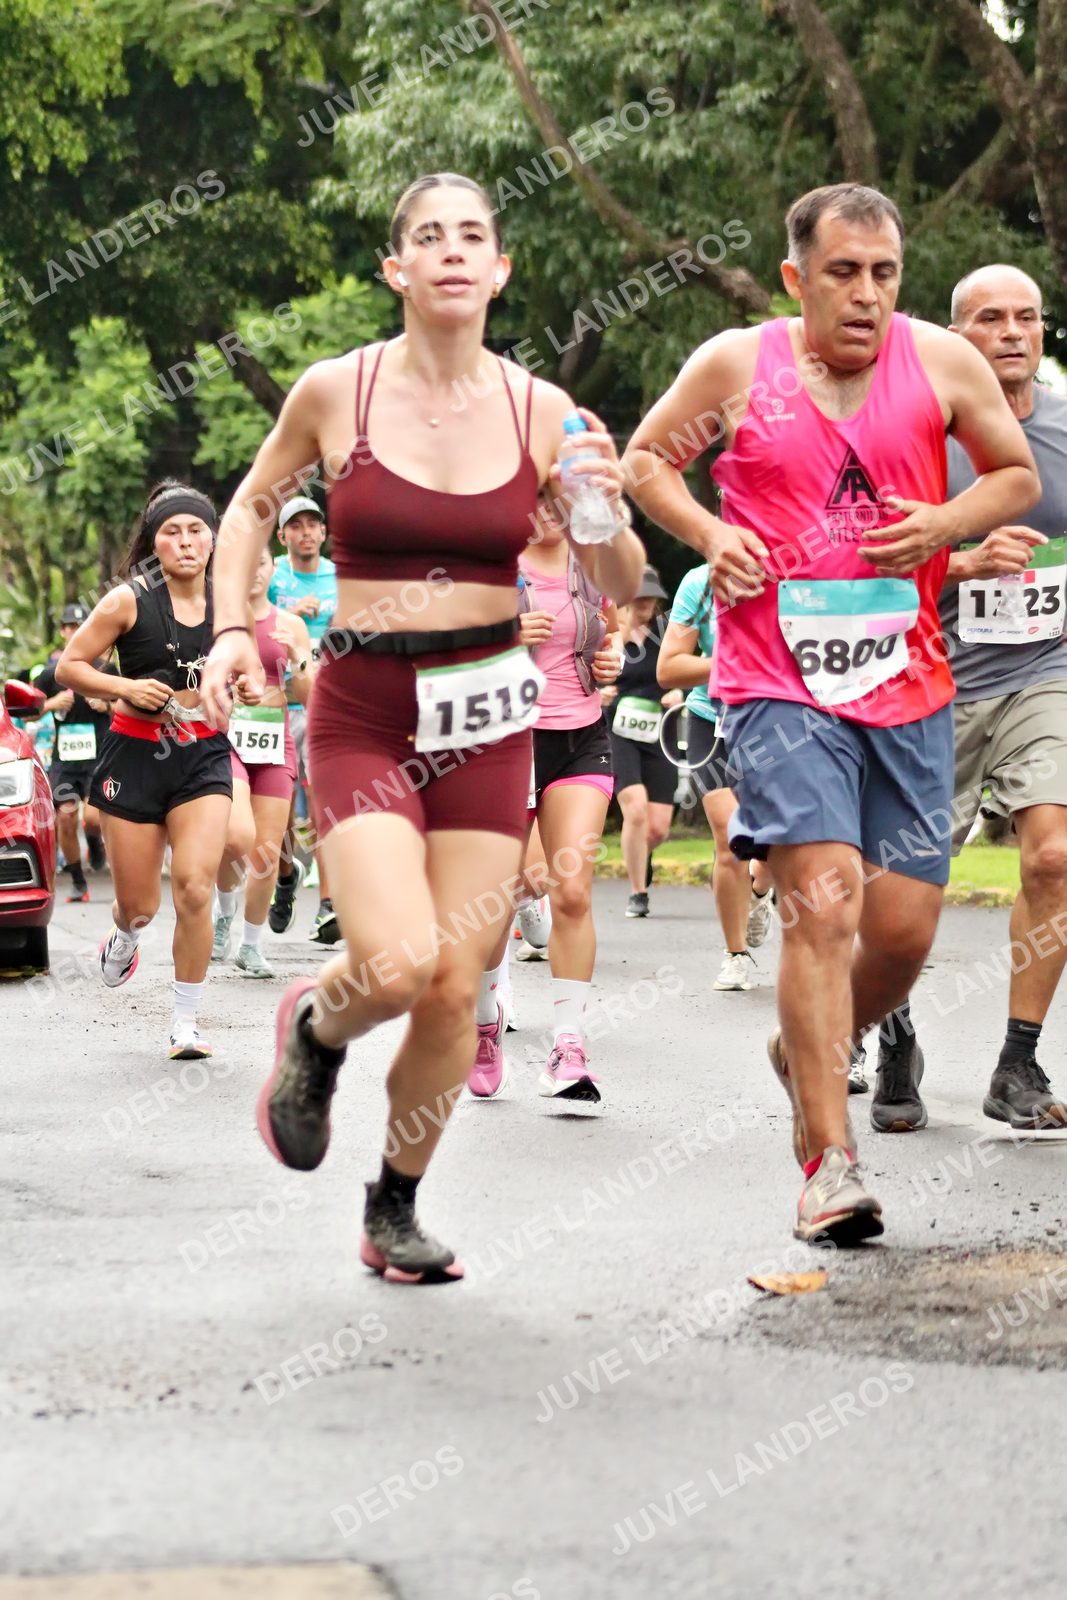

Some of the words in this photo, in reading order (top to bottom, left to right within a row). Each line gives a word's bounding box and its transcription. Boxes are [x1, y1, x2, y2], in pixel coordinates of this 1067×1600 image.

[792, 633, 899, 676] 6800
[435, 679, 538, 736] 1519
[620, 716, 657, 732] 1907
[235, 731, 279, 750] 1561
